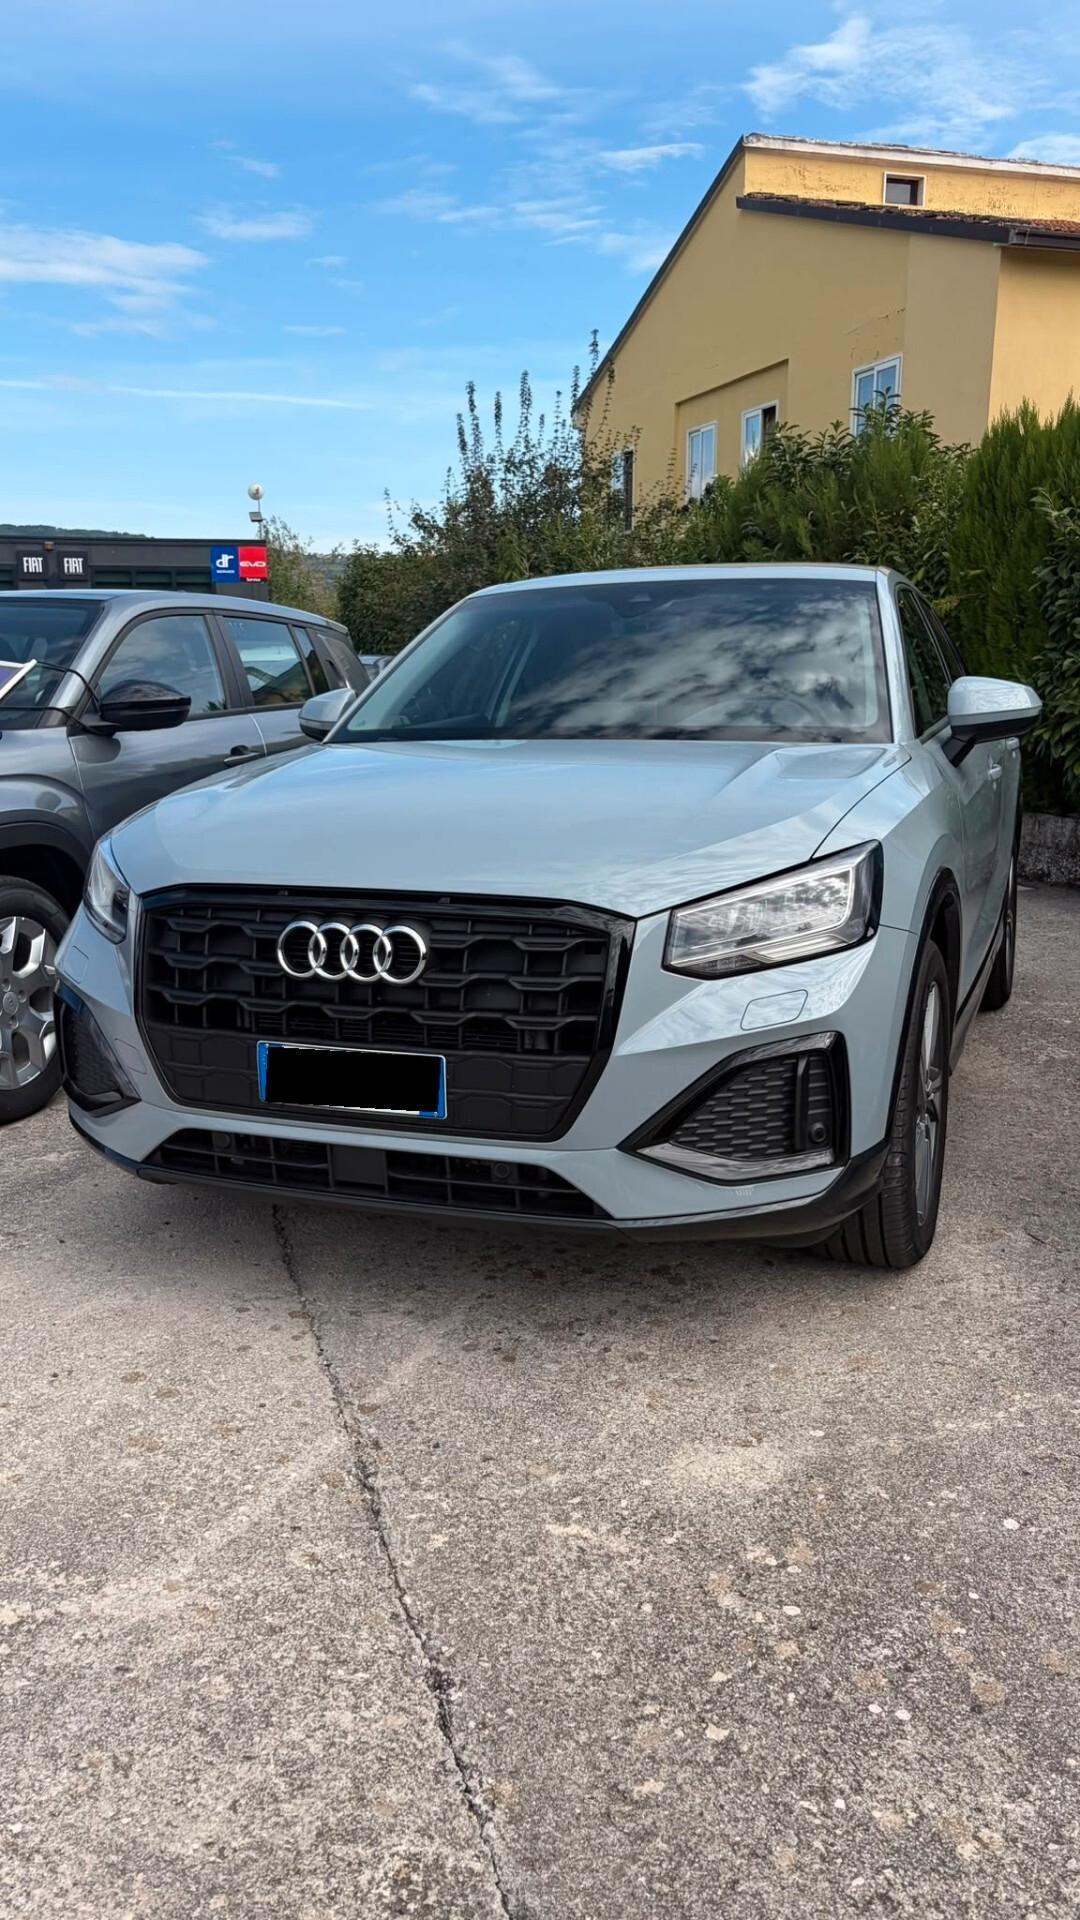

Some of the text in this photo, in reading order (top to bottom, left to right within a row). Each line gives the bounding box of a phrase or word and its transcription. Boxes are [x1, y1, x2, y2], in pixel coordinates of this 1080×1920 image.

[22, 557, 43, 573] FIAT
[63, 557, 84, 573] FIAT
[216, 554, 234, 568] dr
